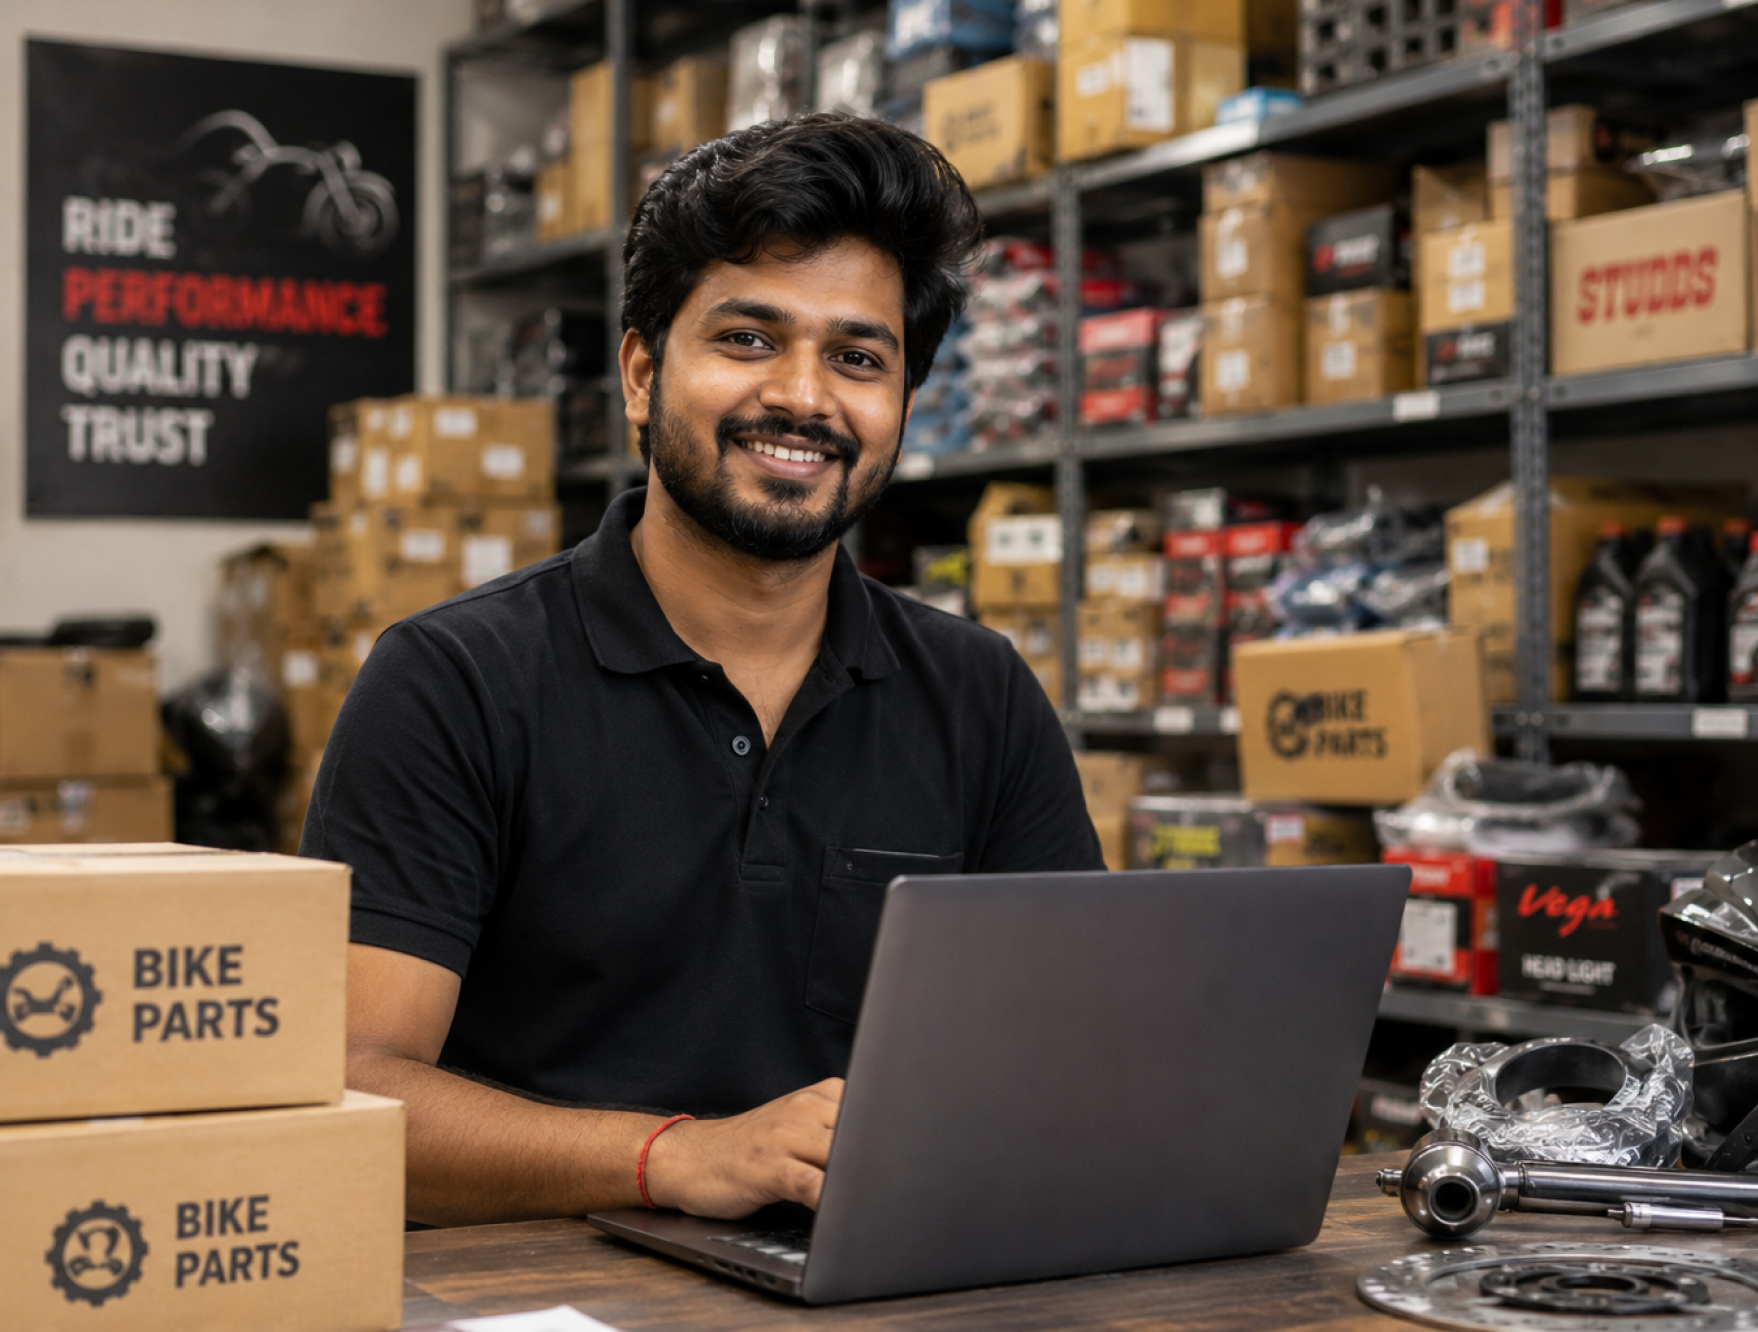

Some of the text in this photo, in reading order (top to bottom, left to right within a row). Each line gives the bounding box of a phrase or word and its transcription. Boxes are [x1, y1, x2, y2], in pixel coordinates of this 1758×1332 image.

[63, 197, 175, 258] RIDE
[63, 267, 388, 337] PERFORMANCE
[1577, 246, 1719, 325] STUDDS
[62, 336, 258, 398] QUALITY
[63, 405, 213, 465] TRUST
[1313, 726, 1387, 760] PARTS
[1517, 883, 1619, 938] Vega
[132, 945, 244, 989] BIKE
[1521, 953, 1617, 986] HEAD LIGHT
[132, 998, 280, 1042] PARTS
[175, 1195, 270, 1239] BIKE
[175, 1241, 300, 1288] PARTS
